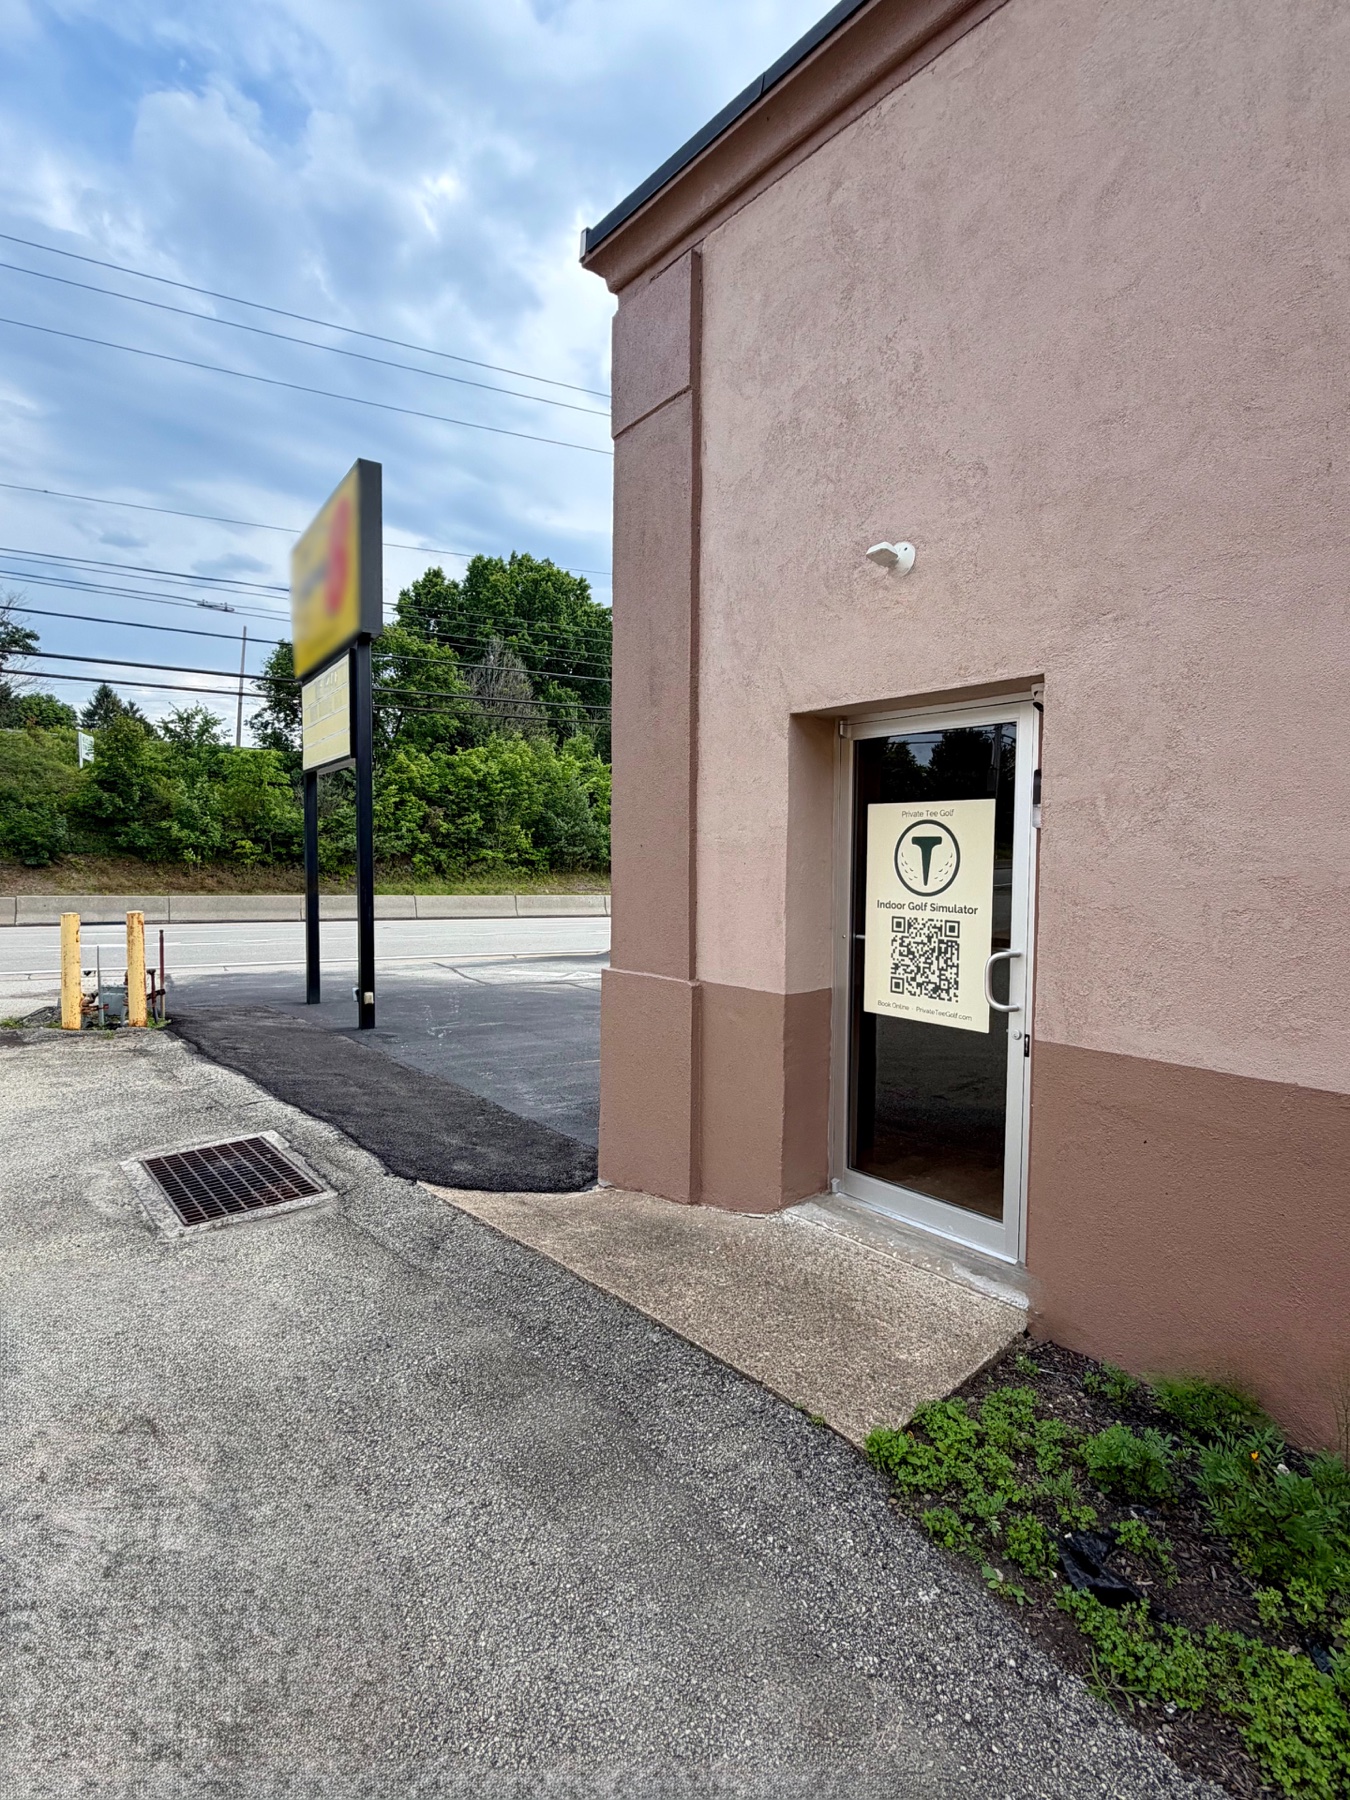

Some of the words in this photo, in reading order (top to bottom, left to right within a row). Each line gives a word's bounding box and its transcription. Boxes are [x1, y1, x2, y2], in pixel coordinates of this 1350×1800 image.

[939, 809, 954, 817] Golf
[877, 900, 906, 910] Indoor
[908, 902, 928, 911] Golf
[930, 903, 978, 915] Simulator
[877, 1000, 892, 1008] Book
[892, 1002, 910, 1011] Online
[916, 1006, 972, 1021] PrivateTeeGolf.com
